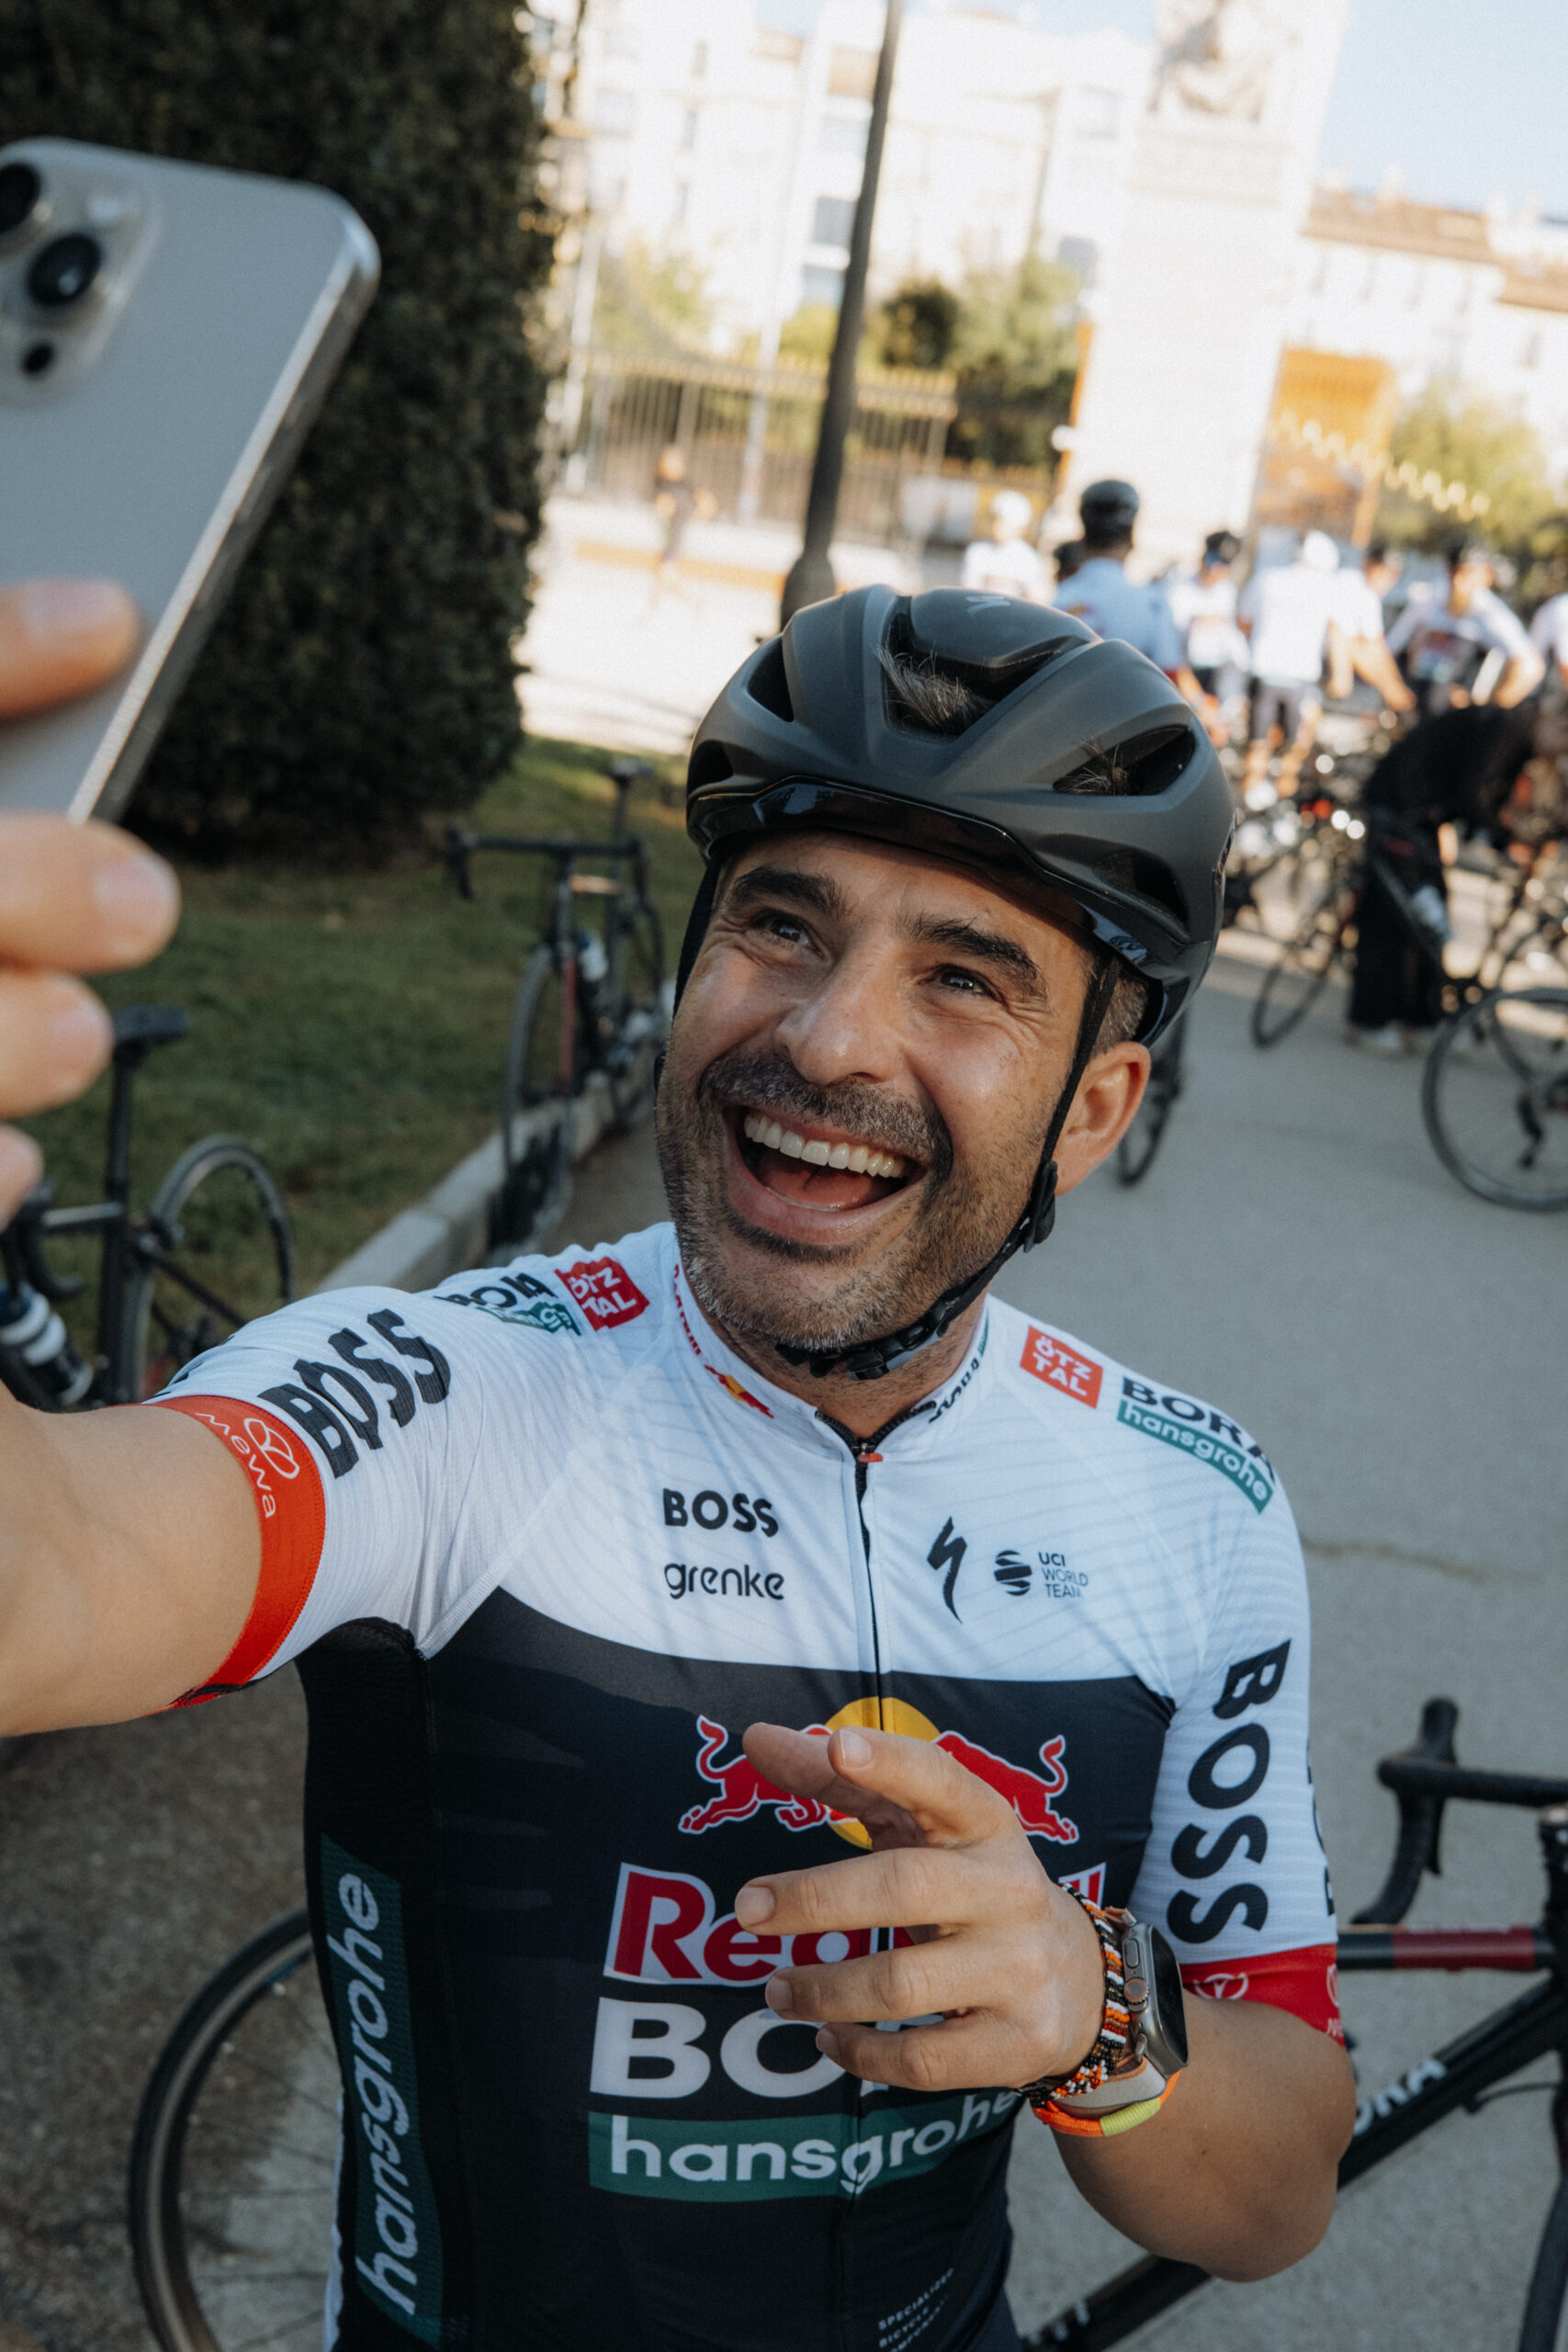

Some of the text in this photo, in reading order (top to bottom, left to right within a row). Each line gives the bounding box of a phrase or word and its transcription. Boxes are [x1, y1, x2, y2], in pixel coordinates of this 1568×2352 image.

[581, 1291, 637, 1317] TAL
[1032, 1351, 1087, 1396] TAL
[1034, 1335, 1091, 1381] ÖTZ
[257, 1308, 451, 1479] BOSS
[1123, 1399, 1268, 1501] hansgrohe
[662, 1487, 779, 1537] BOSS
[663, 1562, 785, 1600] grenke
[1038, 1551, 1066, 1567] UCI
[1042, 1567, 1089, 1587] WORLD
[1167, 1638, 1292, 1945] BOSS
[327, 1871, 418, 2316] hansgrohe
[610, 2091, 1018, 2194] hansgrohe
